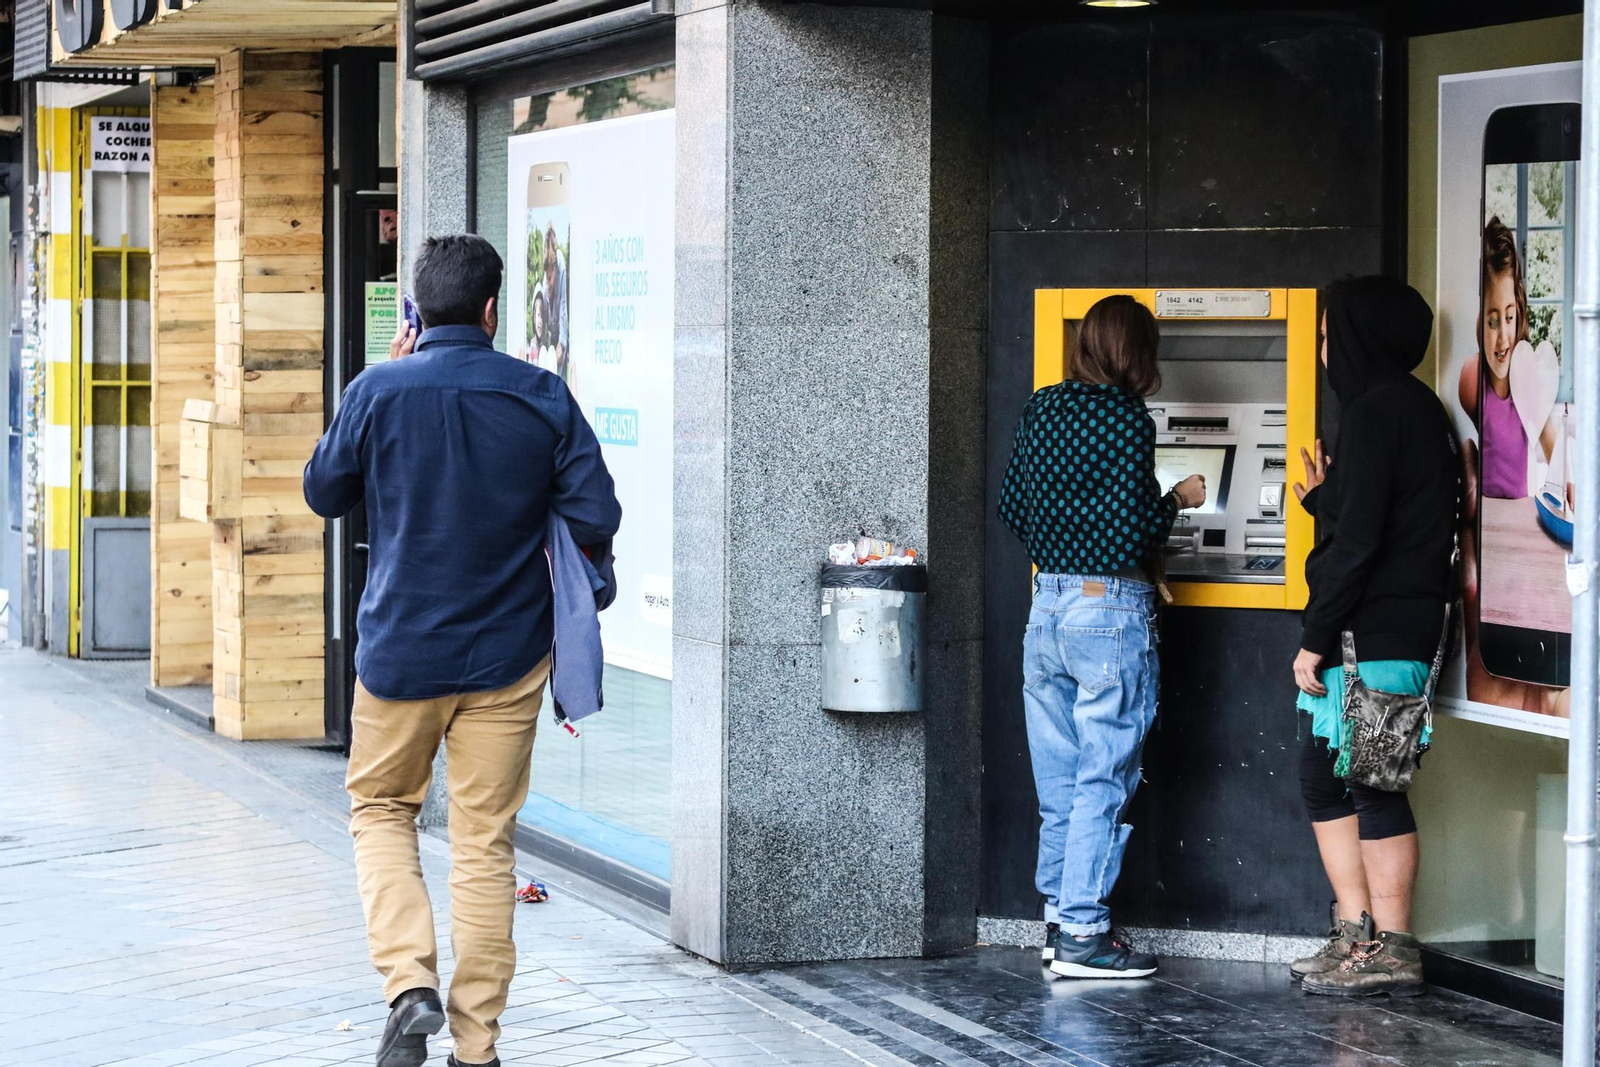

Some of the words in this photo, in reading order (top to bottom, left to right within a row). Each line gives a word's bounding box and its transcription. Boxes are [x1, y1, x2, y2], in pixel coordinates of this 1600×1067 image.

[98, 121, 112, 131] SE
[116, 122, 150, 132] ALQU
[95, 151, 138, 161] RAZON
[595, 239, 600, 264] 3
[601, 233, 624, 264] AÑOS
[627, 236, 644, 262] CON
[595, 272, 609, 297] MIS
[611, 270, 649, 297] SEGUROS
[1188, 296, 1203, 304] 4142
[595, 305, 605, 330] AL
[606, 305, 635, 330] MISMO
[595, 339, 622, 365] PRECIO
[596, 412, 608, 440] ME
[609, 413, 637, 441] GUSTA
